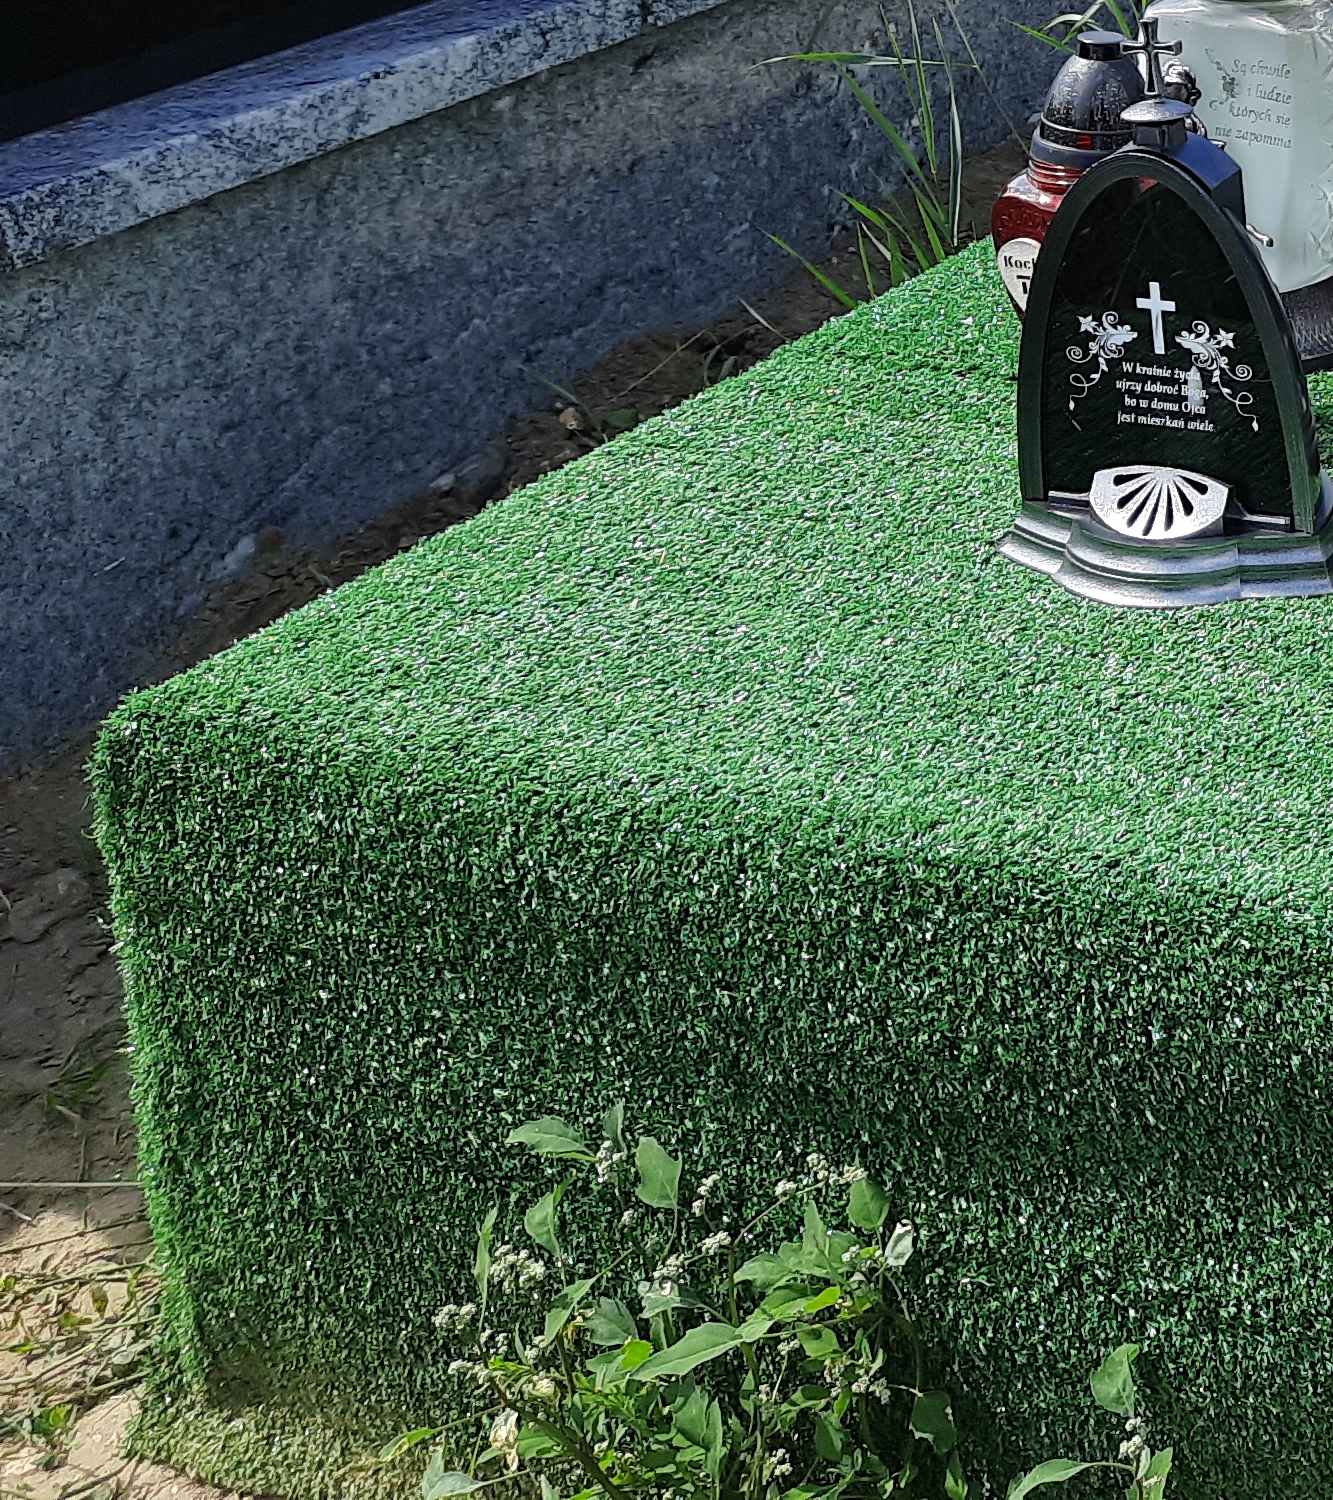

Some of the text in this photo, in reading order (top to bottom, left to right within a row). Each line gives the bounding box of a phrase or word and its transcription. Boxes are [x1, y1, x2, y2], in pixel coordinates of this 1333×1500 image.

[1250, 60, 1291, 79] chwile
[1255, 84, 1292, 105] ludzie
[1229, 101, 1272, 124] których
[1214, 124, 1292, 149] nie zapomina
[1122, 361, 1134, 373] W
[1144, 380, 1179, 395] dobroć
[1124, 394, 1137, 407] bo
[1139, 399, 1149, 408] w
[1150, 397, 1179, 411] domu
